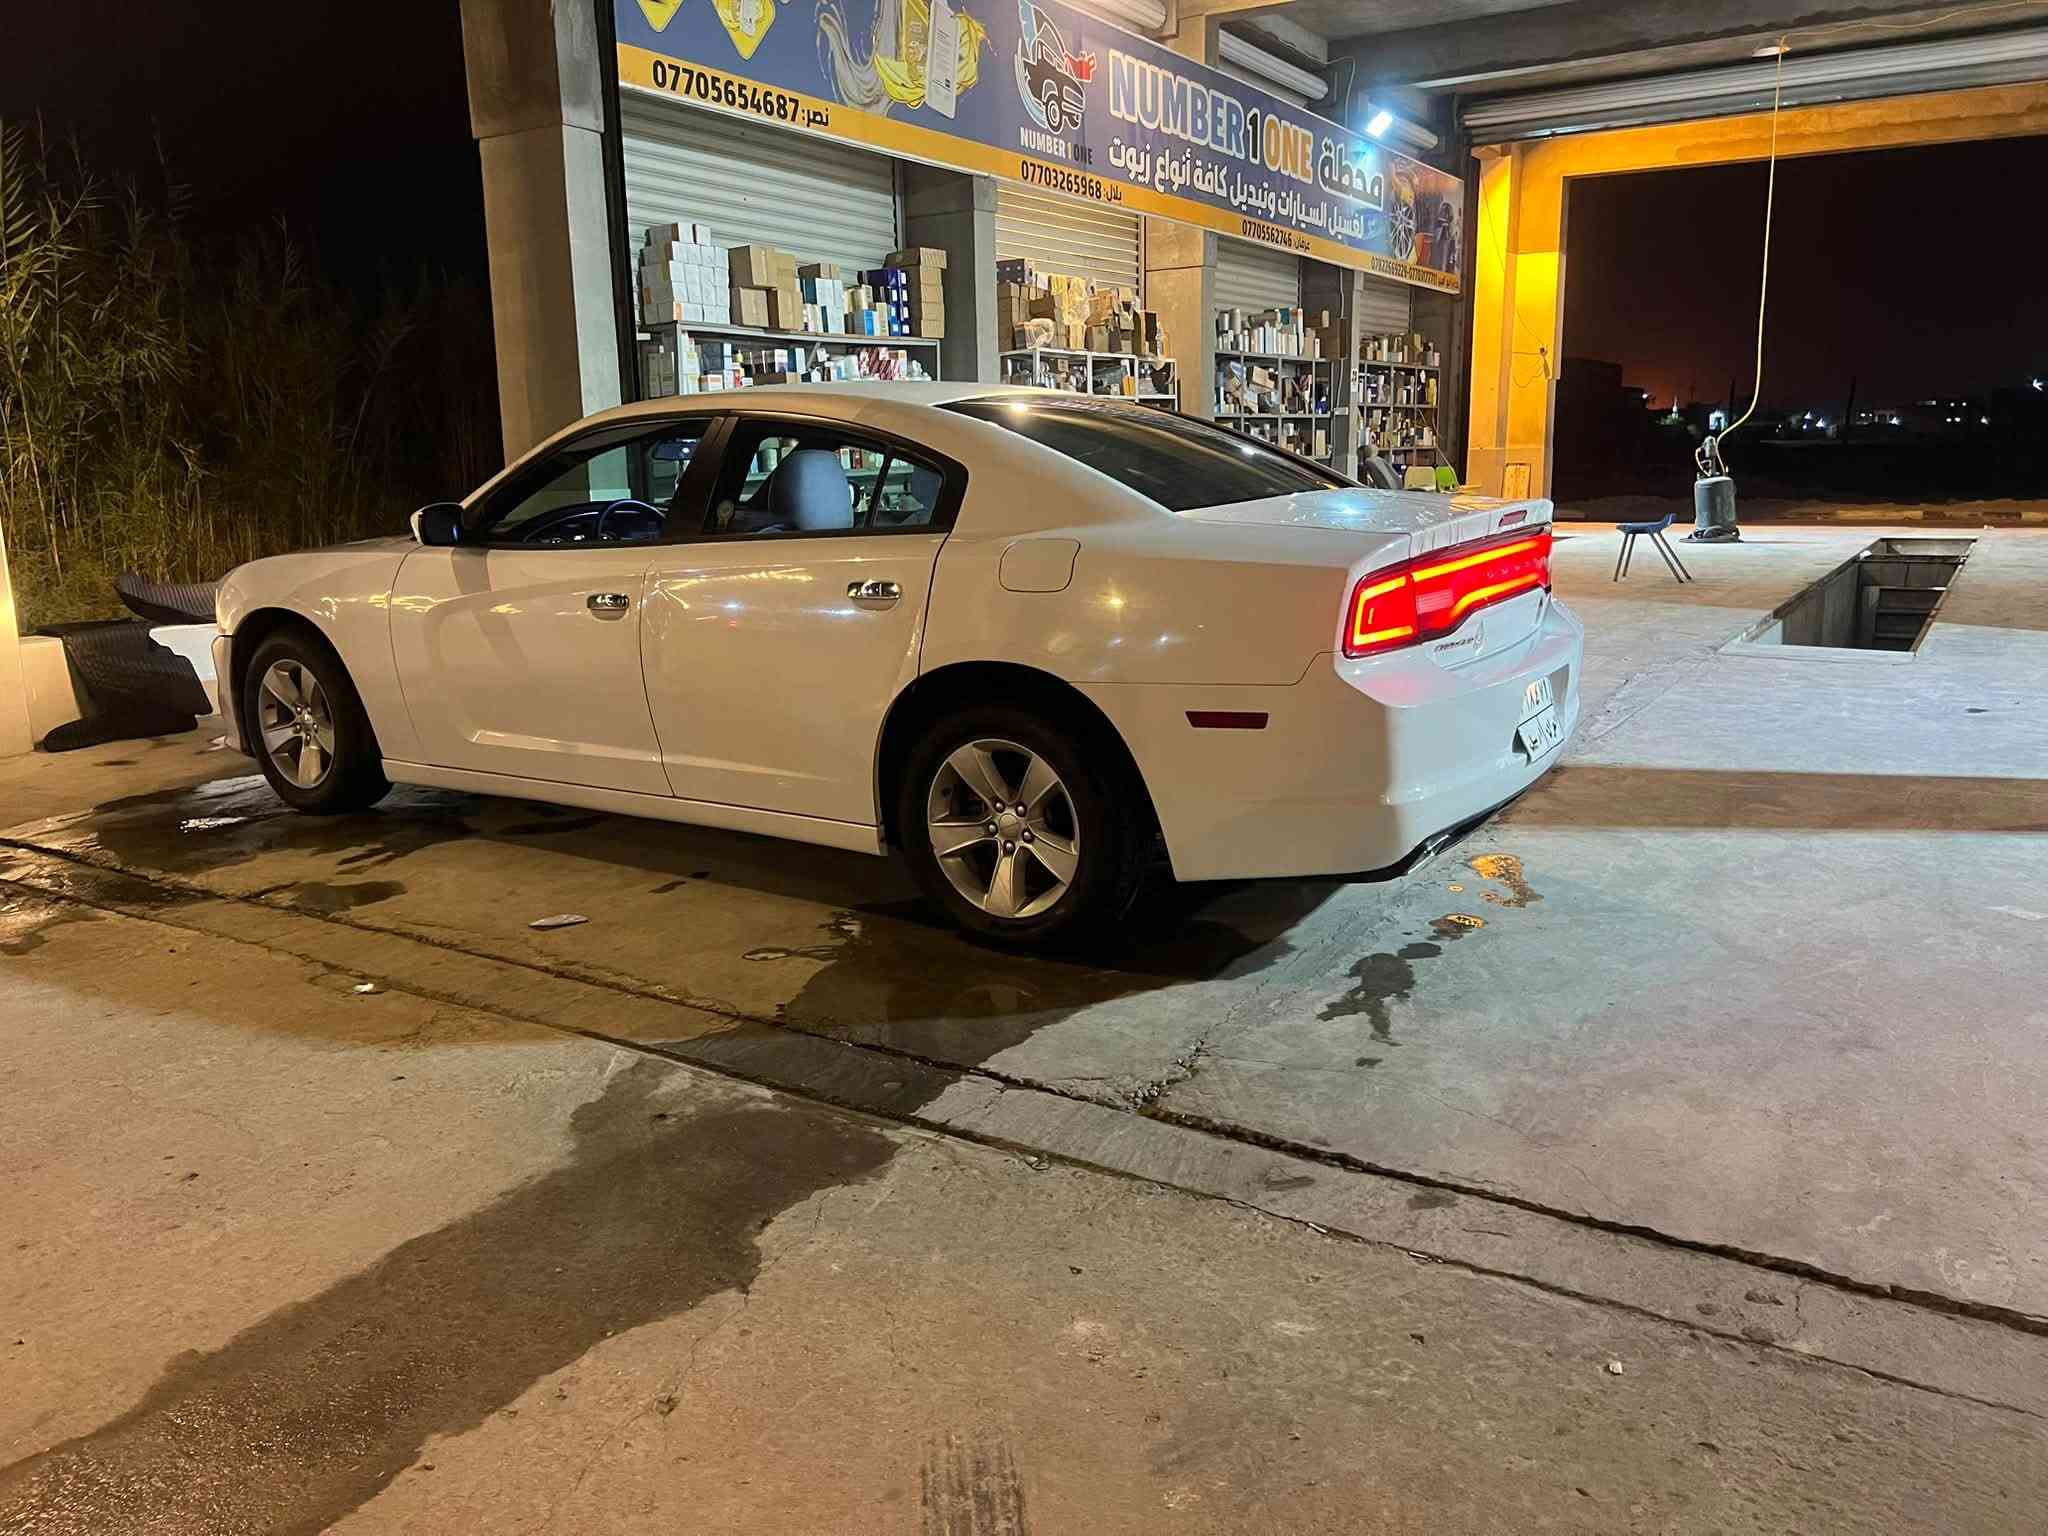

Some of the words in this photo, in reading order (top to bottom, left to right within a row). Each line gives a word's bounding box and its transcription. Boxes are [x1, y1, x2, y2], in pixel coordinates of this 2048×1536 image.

[652, 59, 800, 123] 07705654687
[1108, 48, 1244, 160] NUMBER
[1020, 127, 1065, 159] NUMBER
[1073, 144, 1093, 165] ONE
[1108, 137, 1151, 184] زيوت
[1264, 114, 1314, 184] ONE
[1021, 160, 1102, 200] 07703265968
[1154, 147, 1191, 193] أنواع
[1193, 159, 1227, 198] كافة
[1318, 137, 1384, 209] محطة
[1229, 172, 1276, 220] وتبديل
[1277, 190, 1327, 229] السيارات
[1242, 219, 1293, 248] 07705562746
[1328, 206, 1364, 240] لغسيل
